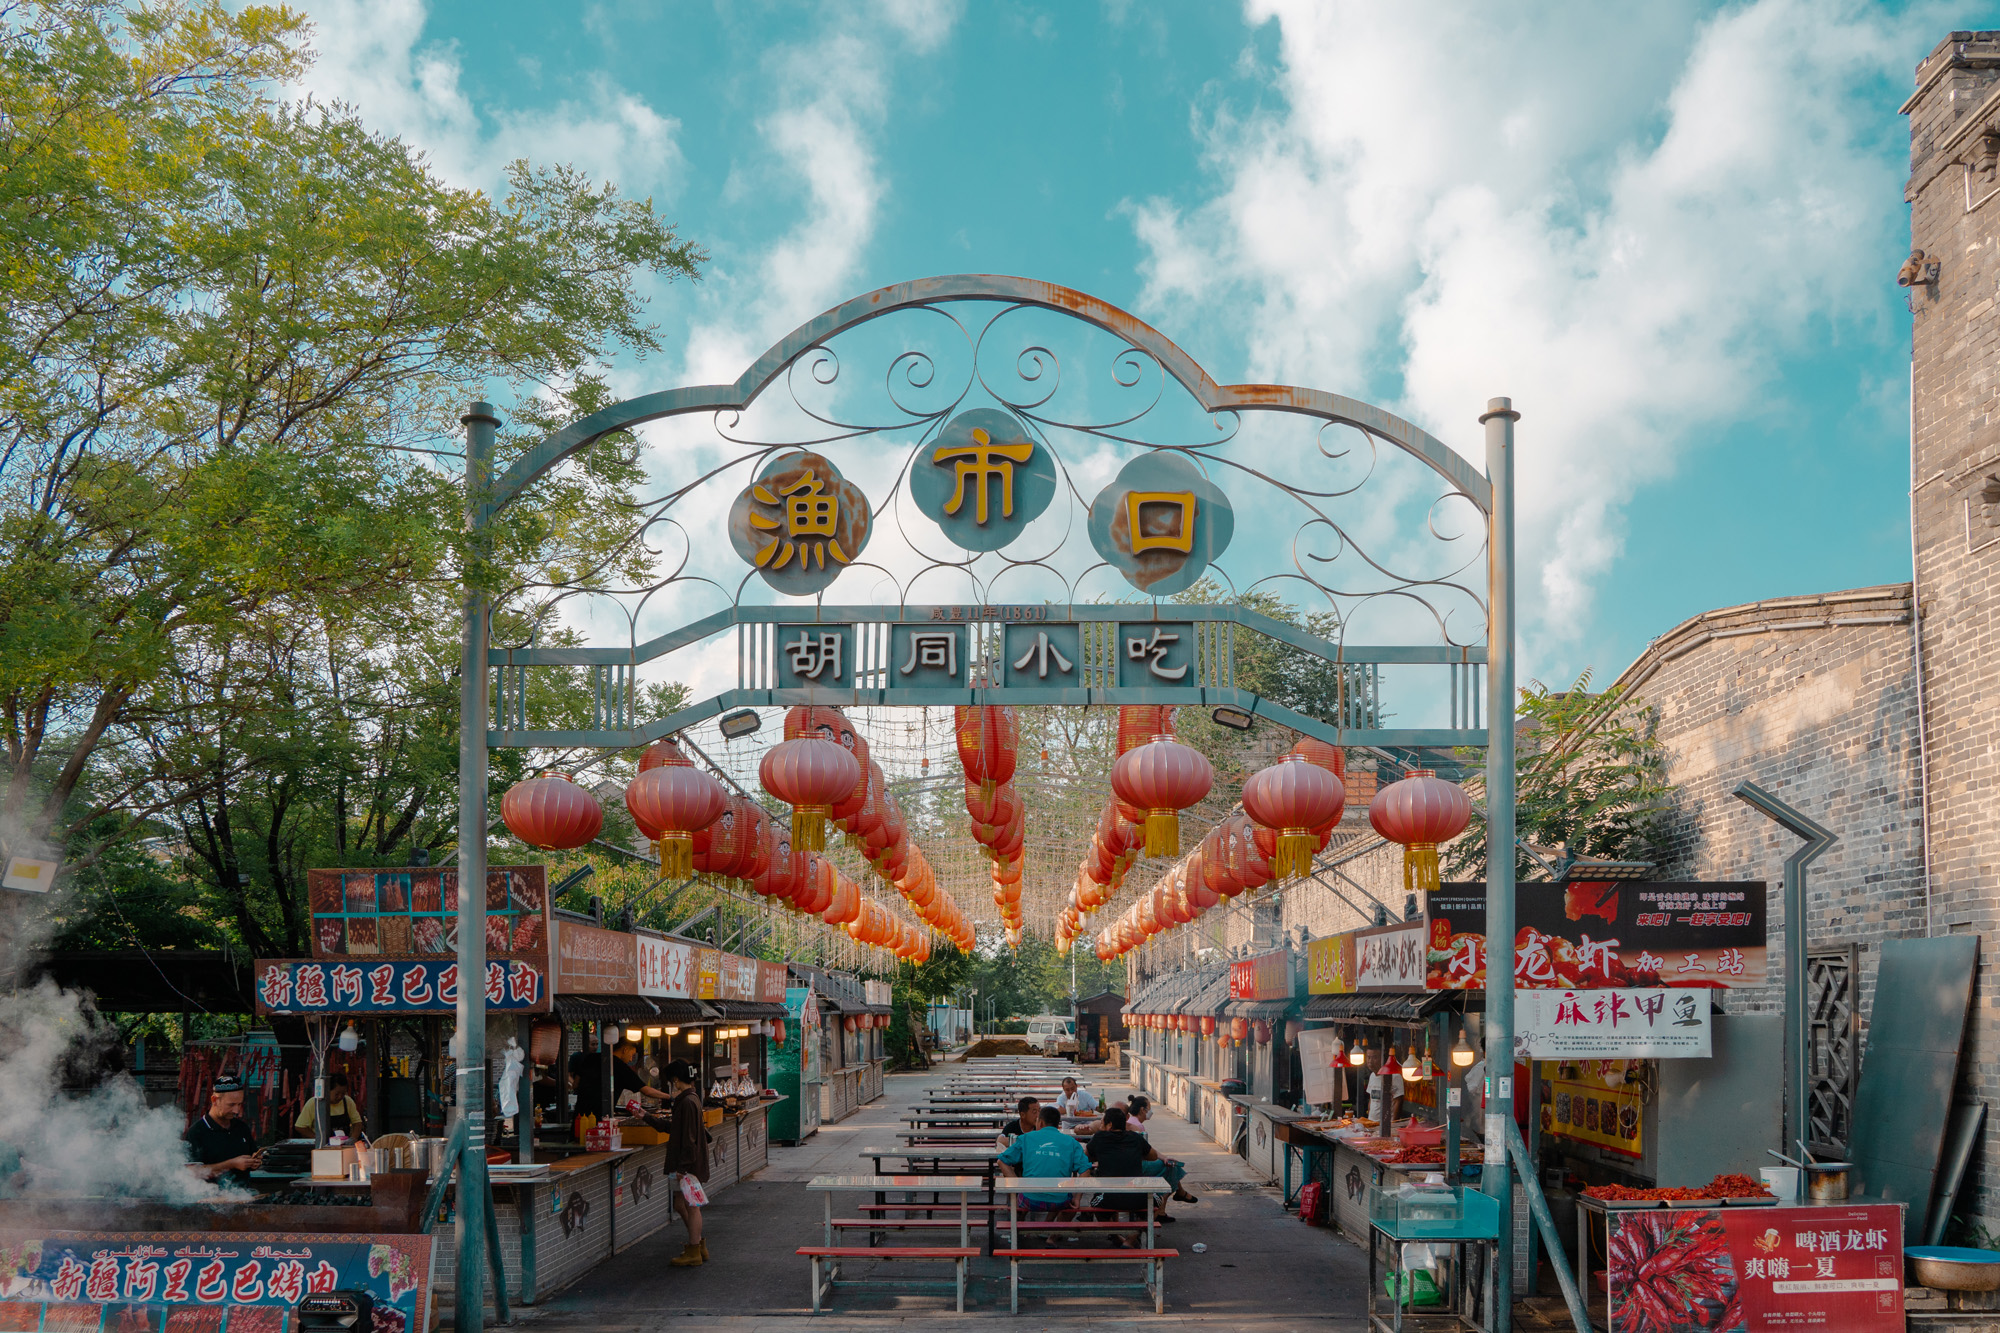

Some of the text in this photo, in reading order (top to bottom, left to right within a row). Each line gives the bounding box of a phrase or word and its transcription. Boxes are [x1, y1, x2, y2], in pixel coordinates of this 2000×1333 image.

[750, 428, 1196, 570] 漁市口
[784, 627, 1189, 681] 胡同小吃
[1434, 921, 1447, 948] 小杨
[648, 944, 693, 993] 生蚝之家
[1635, 948, 1745, 976] 加工站
[1554, 991, 1703, 1029] 麻辣甲鱼
[1795, 1228, 1888, 1252] 啤酒龙虾
[51, 1257, 339, 1303] 新疆阿里巴巴烤肉
[1744, 1255, 1837, 1280] 爽嗨一夏
